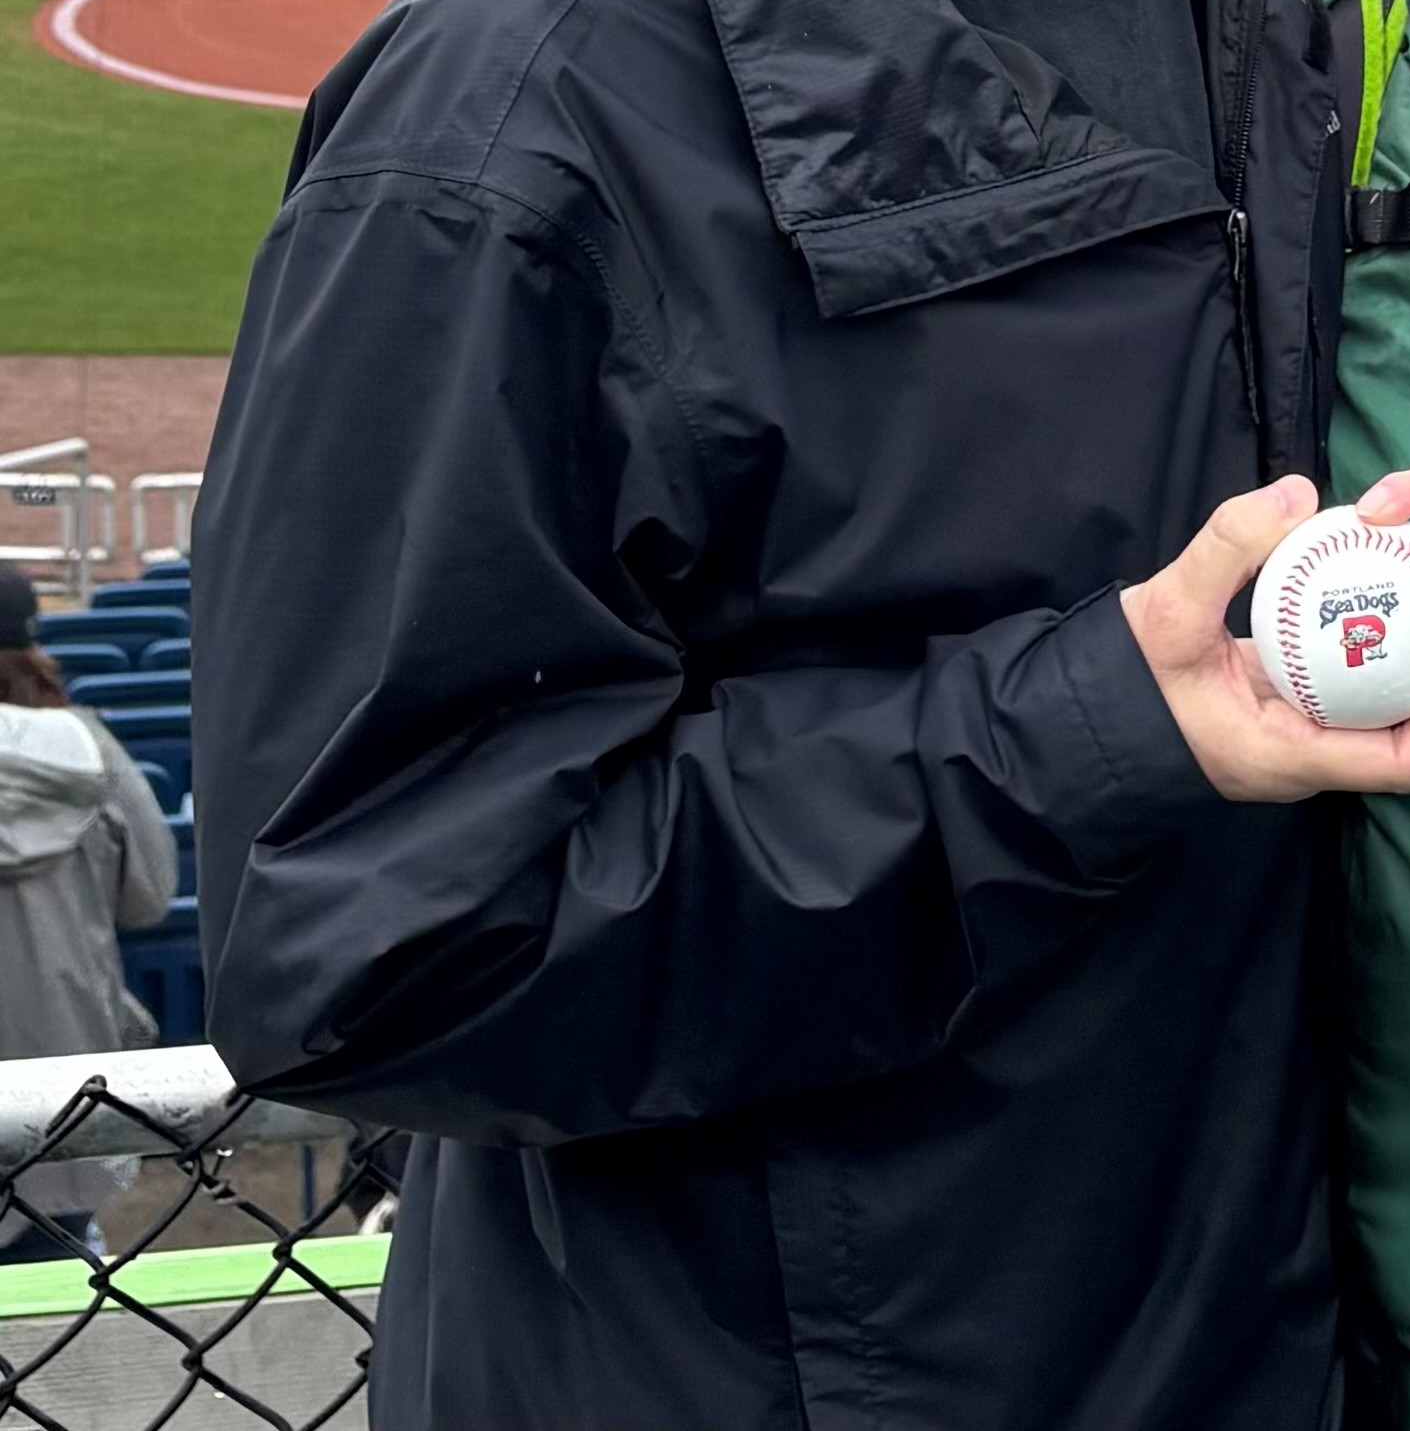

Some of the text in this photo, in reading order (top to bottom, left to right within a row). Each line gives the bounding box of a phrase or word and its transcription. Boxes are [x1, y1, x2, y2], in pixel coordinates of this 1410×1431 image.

[1321, 580, 1396, 598] PORTLAND
[1318, 590, 1400, 630] Sea Dogs
